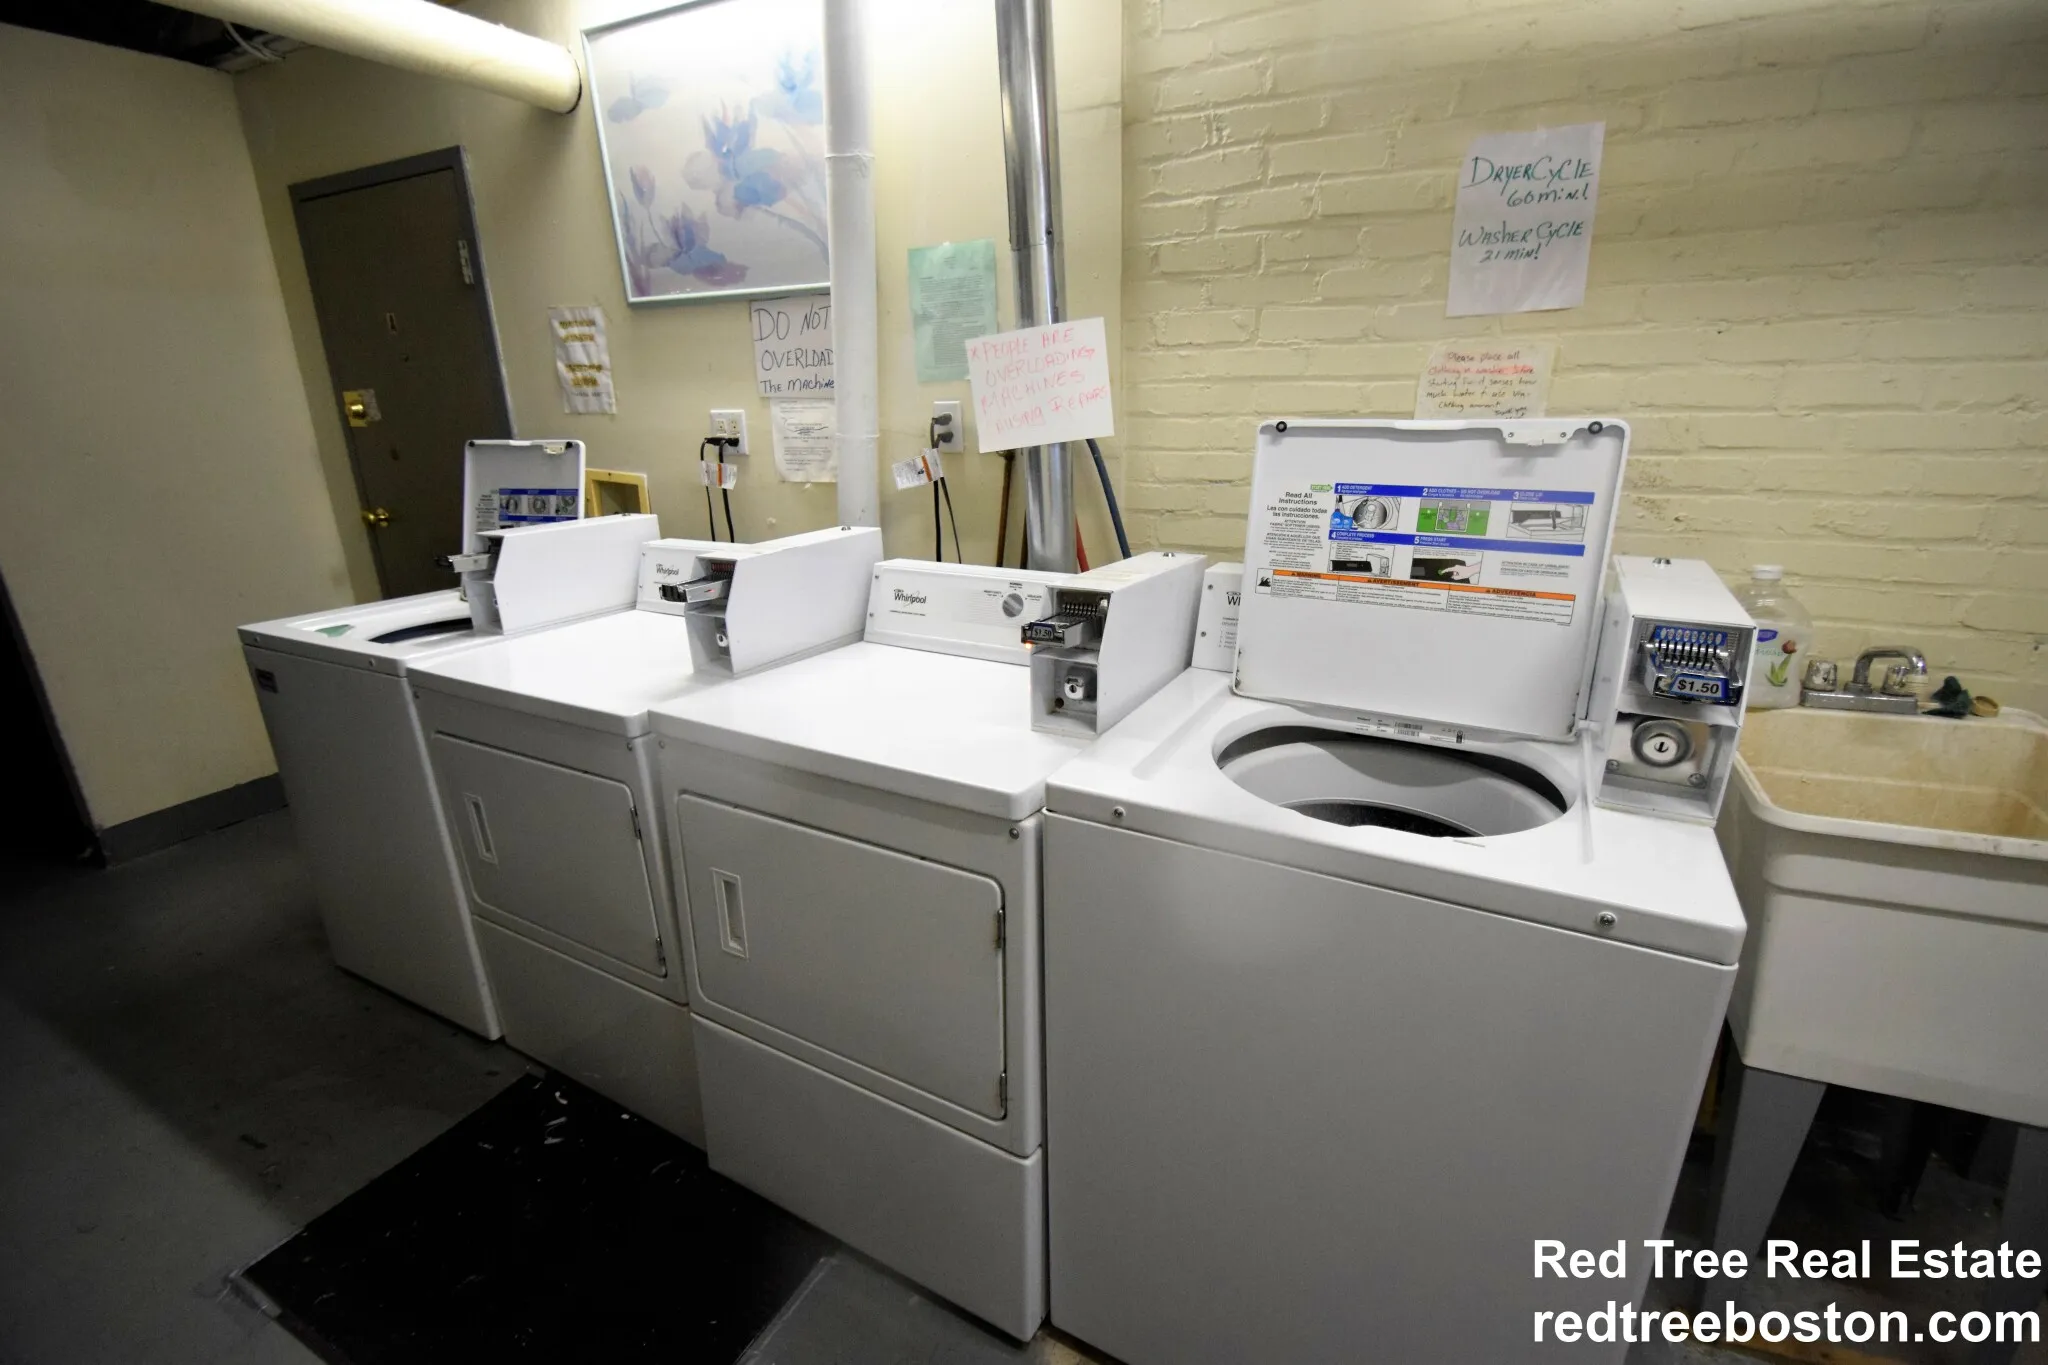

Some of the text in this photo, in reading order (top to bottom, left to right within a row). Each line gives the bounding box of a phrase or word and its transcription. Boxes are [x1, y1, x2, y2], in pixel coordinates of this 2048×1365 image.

[753, 303, 831, 342] DO NOT
[982, 337, 1029, 363] PEOPLE
[1041, 327, 1074, 349] ARE
[981, 370, 1085, 415] MACHINES
[1422, 488, 1428, 496] 2
[1513, 491, 1519, 500] 3
[1331, 531, 1337, 539] 4
[1414, 536, 1419, 544] 5
[894, 591, 926, 604] Whirlpool
[1677, 679, 1719, 695] $1.50
